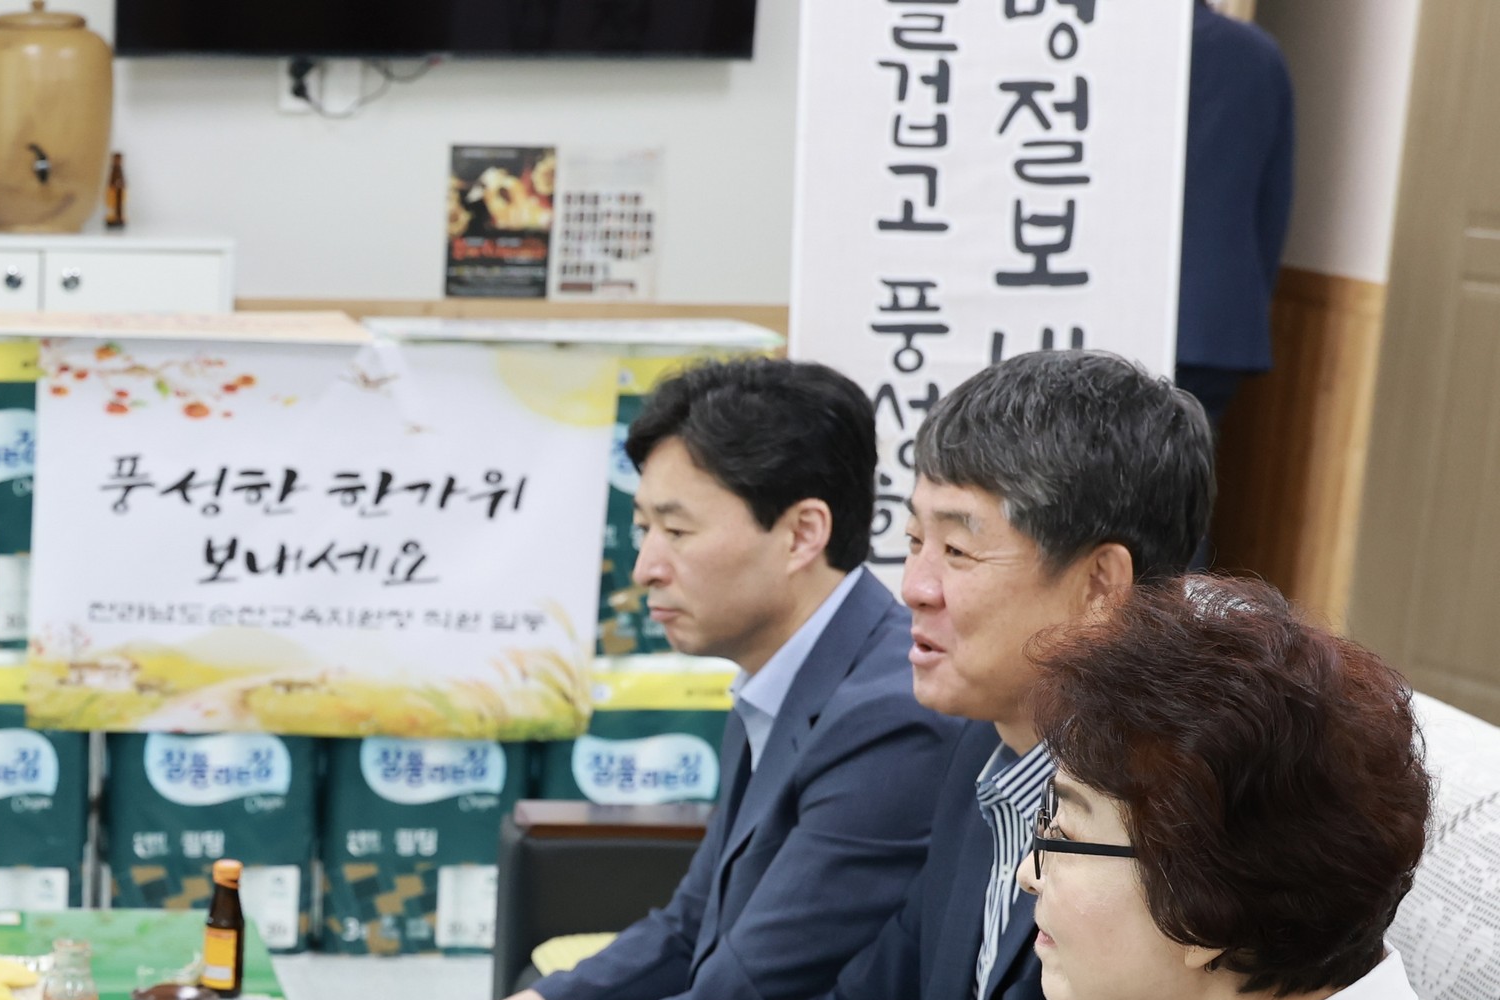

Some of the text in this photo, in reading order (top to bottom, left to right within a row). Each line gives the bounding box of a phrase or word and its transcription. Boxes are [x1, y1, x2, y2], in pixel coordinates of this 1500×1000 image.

[100, 455, 528, 519] 풍성한 한가위
[197, 536, 440, 586] 보내세요
